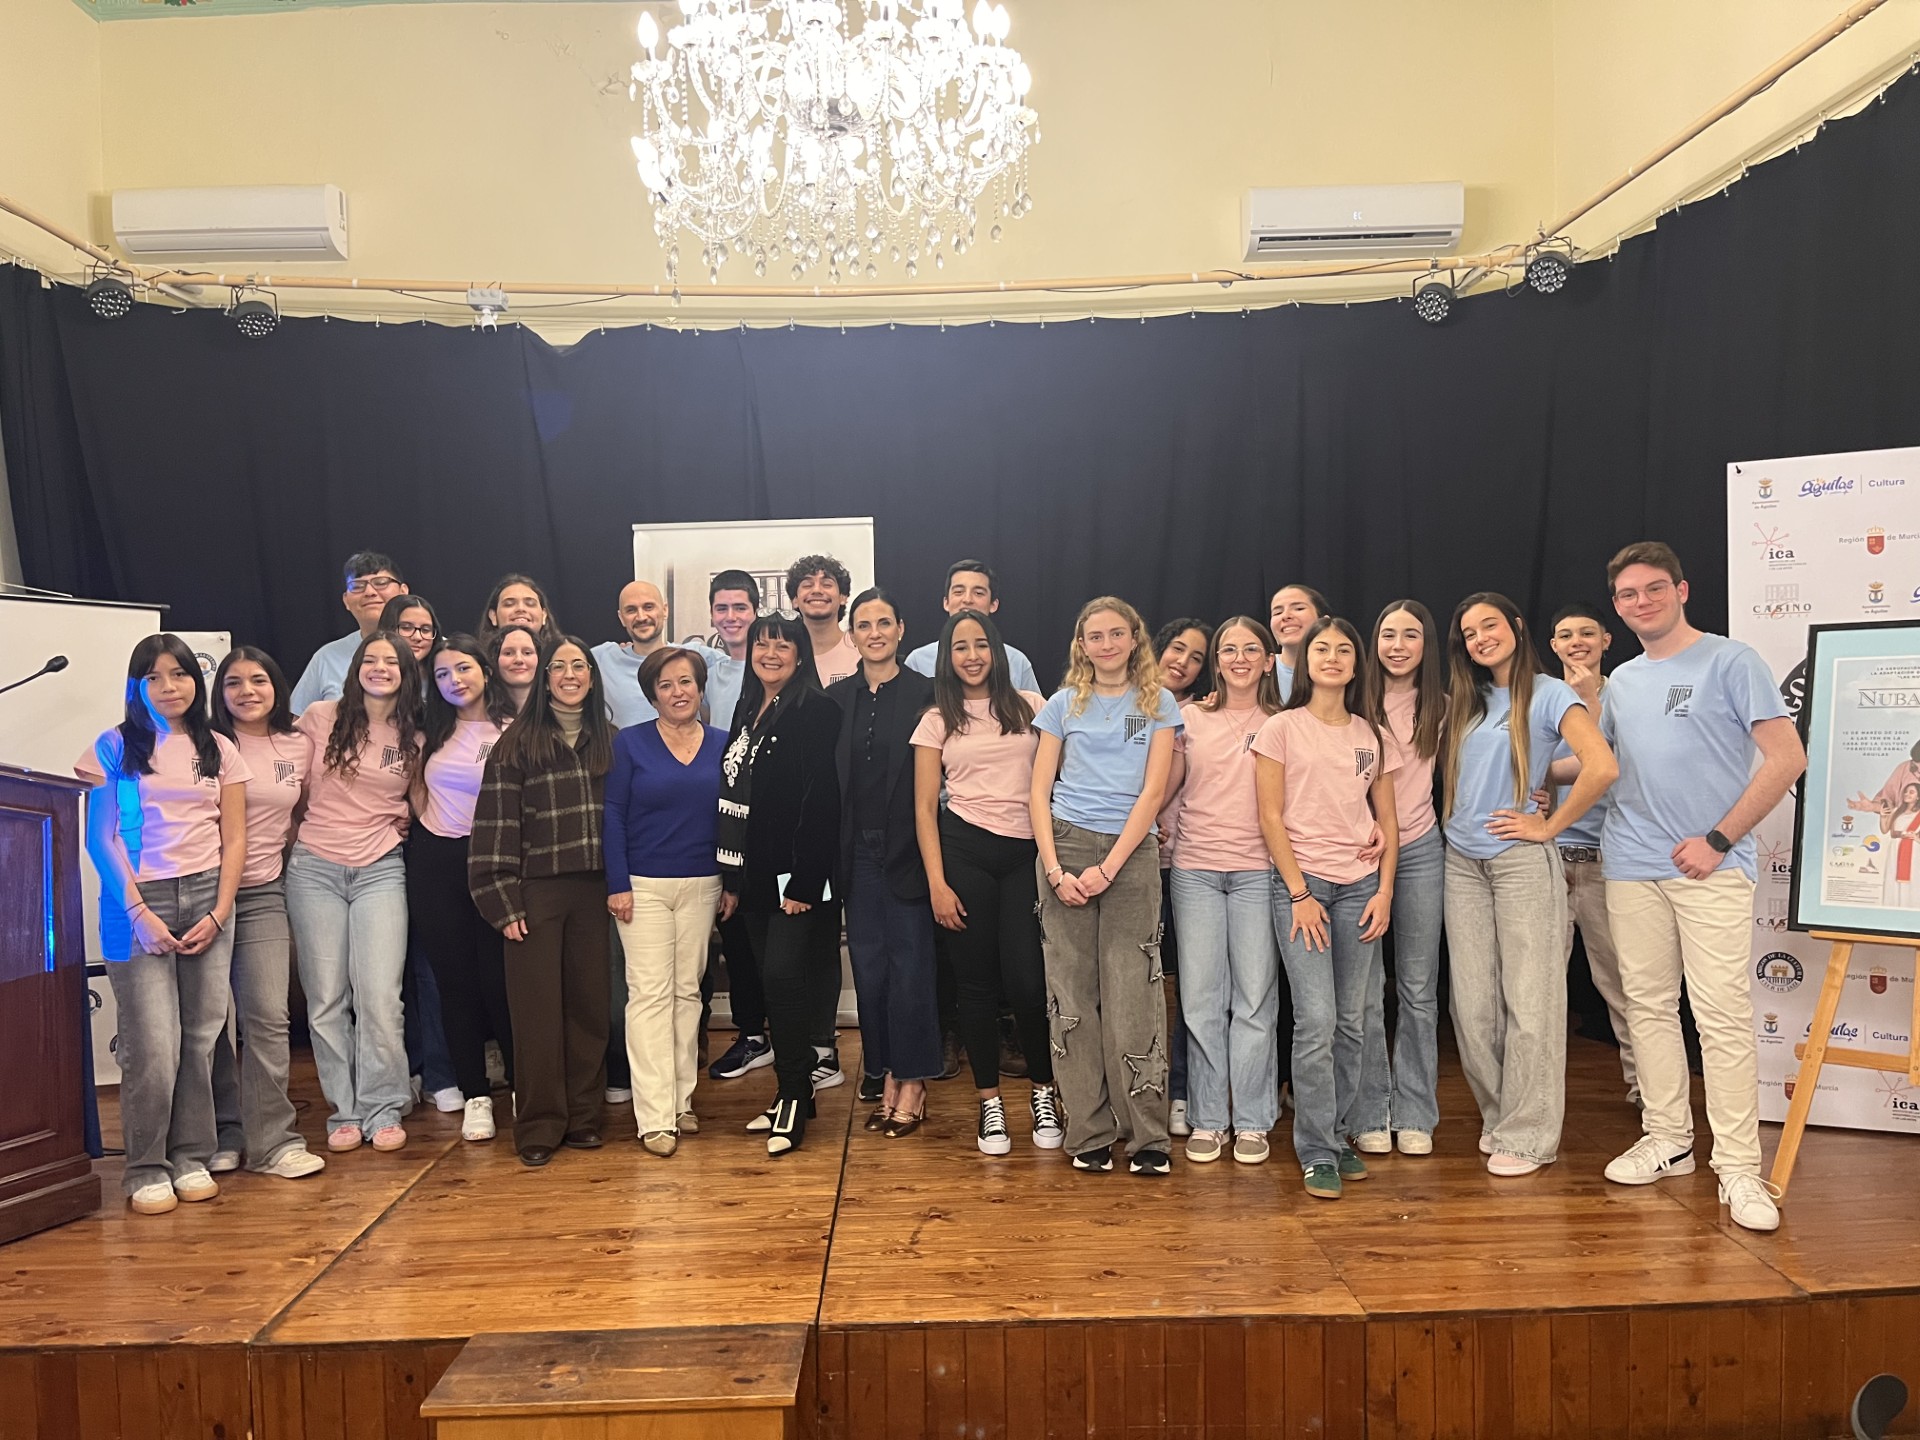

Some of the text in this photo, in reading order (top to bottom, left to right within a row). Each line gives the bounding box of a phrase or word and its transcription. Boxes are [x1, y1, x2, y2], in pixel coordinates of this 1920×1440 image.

[1868, 478, 1905, 488] Cultura
[1838, 536, 1865, 544] Región
[1768, 548, 1795, 560] ica
[1752, 603, 1812, 614] CASINO
[1872, 1031, 1909, 1042] Cultura
[1892, 1097, 1919, 1110] ica
